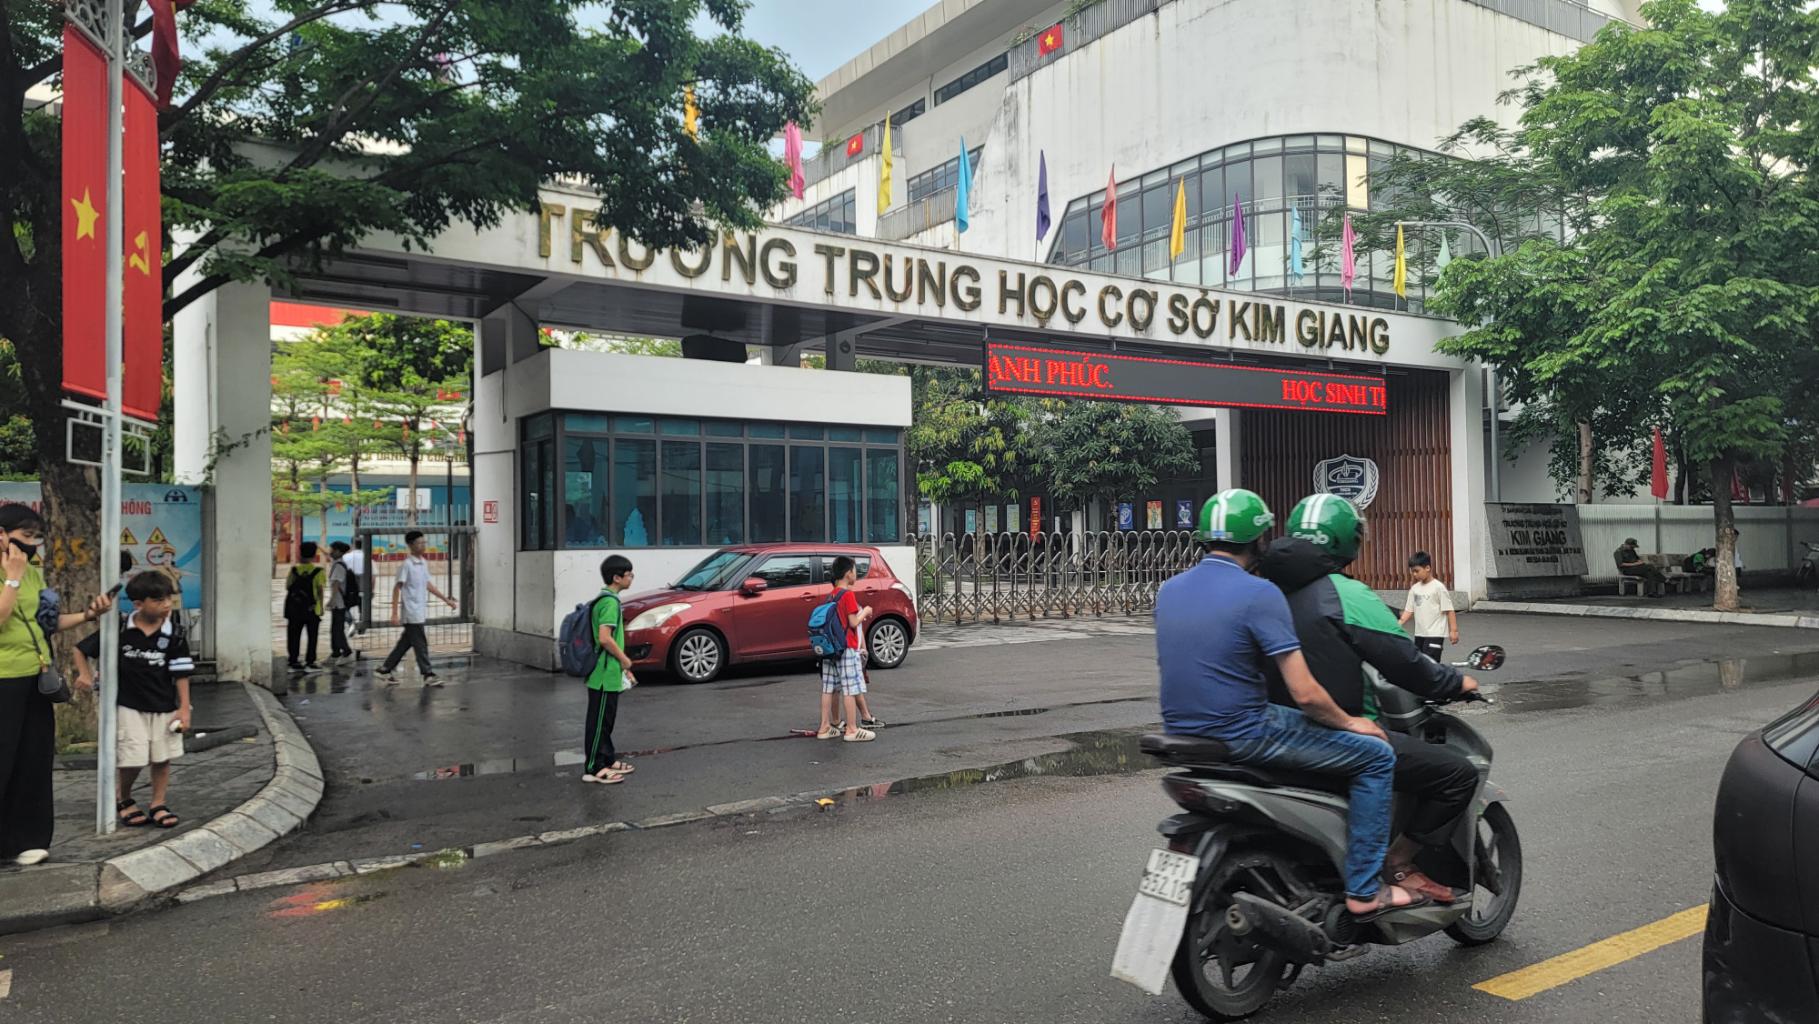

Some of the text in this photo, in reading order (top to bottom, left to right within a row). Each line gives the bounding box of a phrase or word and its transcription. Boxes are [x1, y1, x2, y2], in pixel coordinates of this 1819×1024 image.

[814, 243, 982, 311] TRUNG
[998, 269, 1087, 328] HỌC
[1097, 284, 1158, 331] CƠ
[1167, 289, 1220, 339] SỞ
[1228, 300, 1286, 344] KIM
[1295, 308, 1391, 355] GIANG
[1281, 379, 1322, 406] HỌC
[1325, 382, 1367, 405] SINH
[1510, 529, 1567, 546] KIM GIANG
